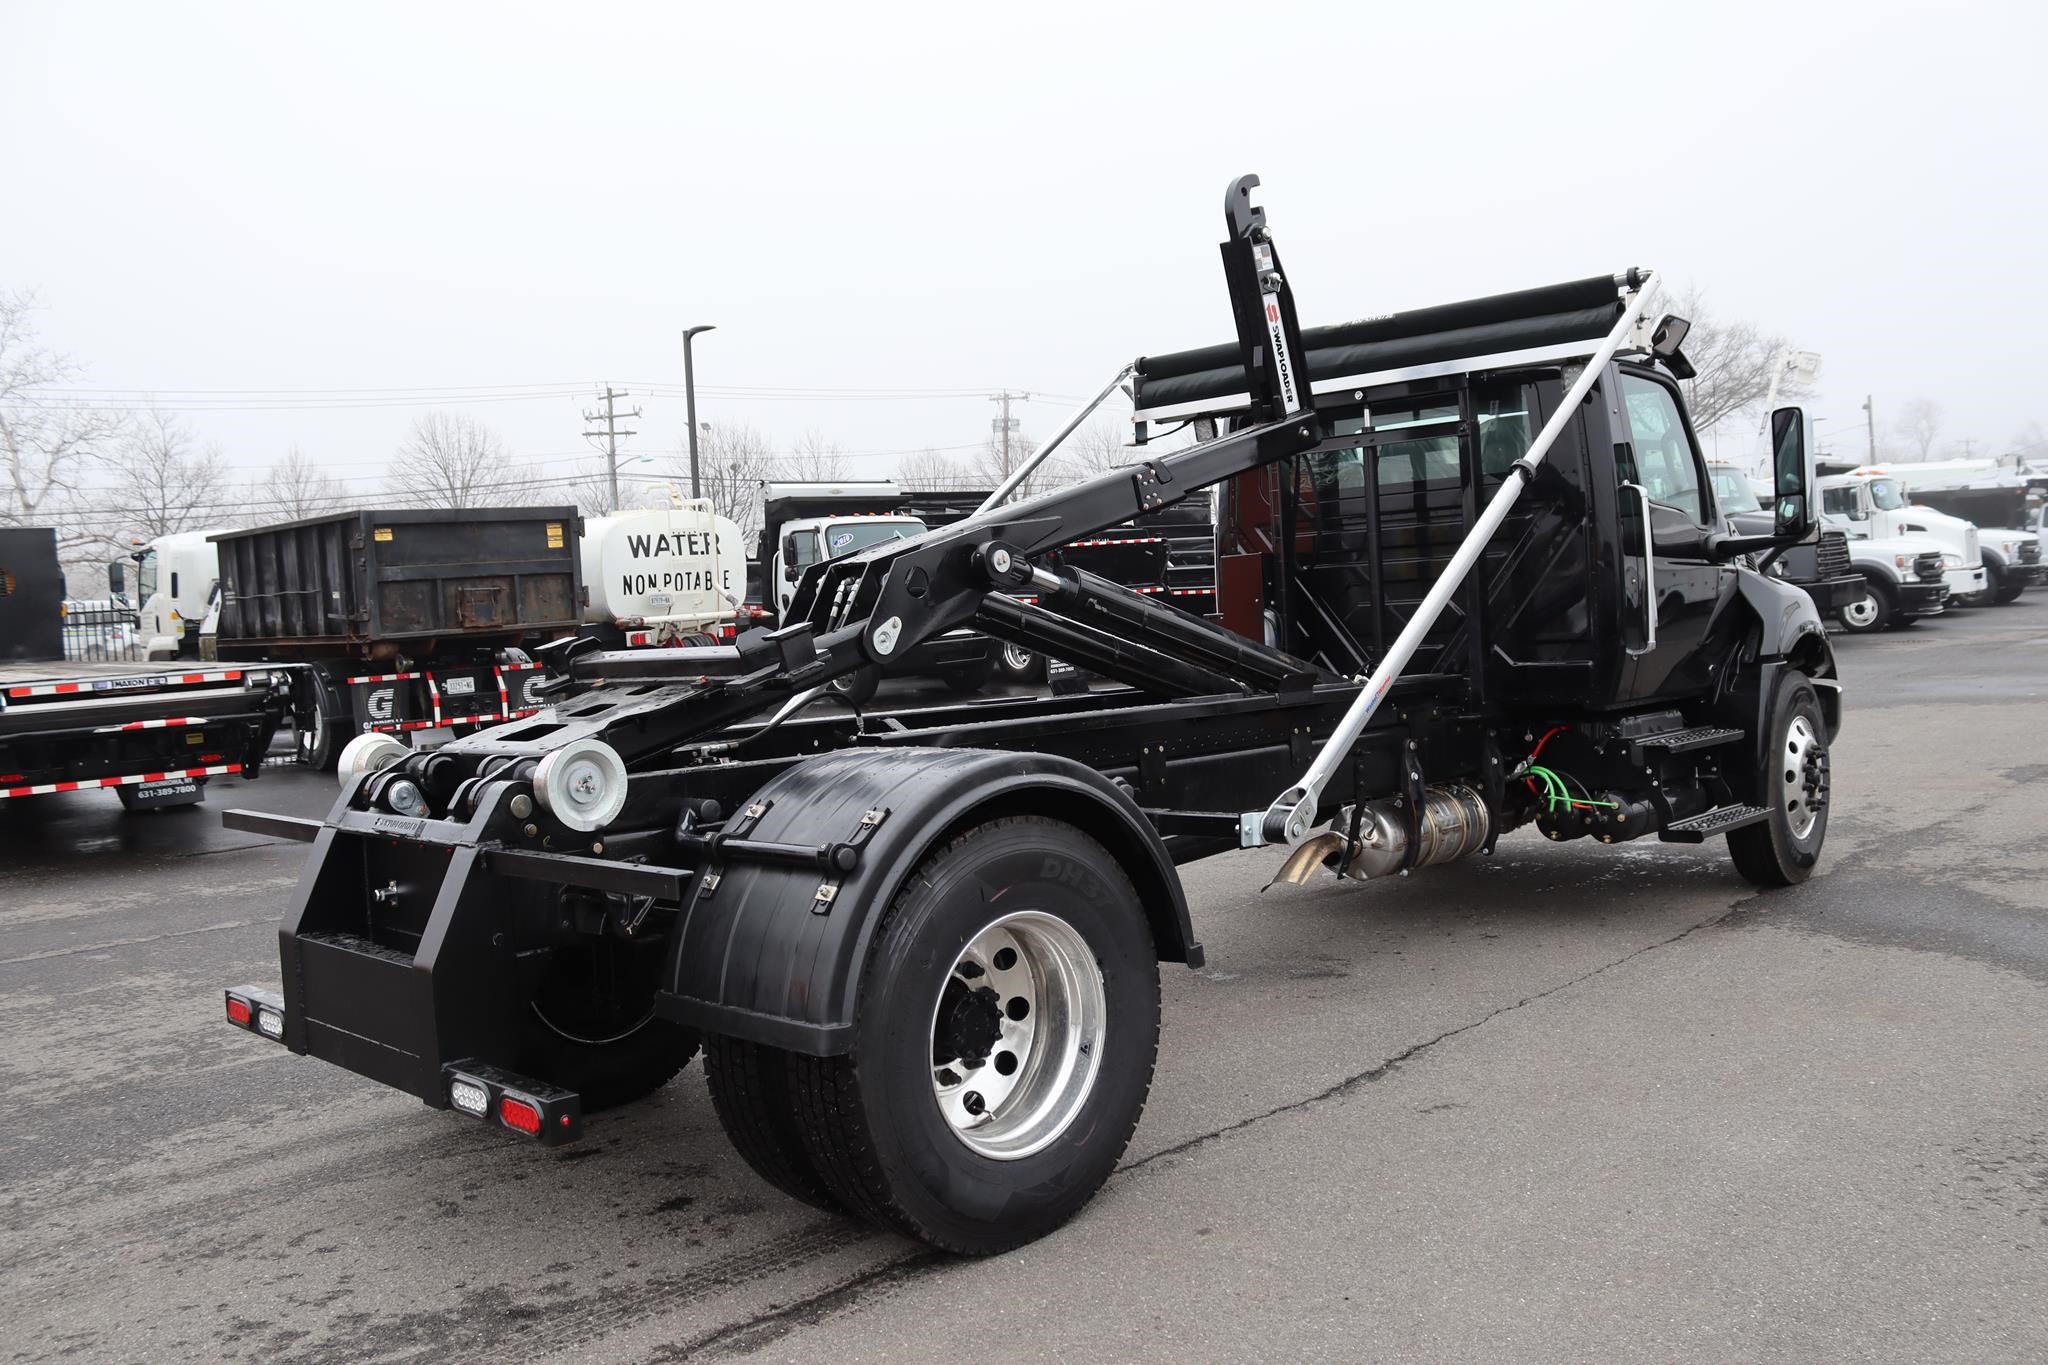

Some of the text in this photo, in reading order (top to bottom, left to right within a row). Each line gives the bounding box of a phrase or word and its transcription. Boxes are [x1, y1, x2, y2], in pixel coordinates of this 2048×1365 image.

[1272, 325, 1294, 404] SWAPLOADER
[626, 532, 722, 559] WATER
[622, 569, 731, 596] NON POTABE
[115, 679, 146, 689] MAXON
[367, 688, 395, 719] G
[137, 784, 197, 799] 631-389-7800
